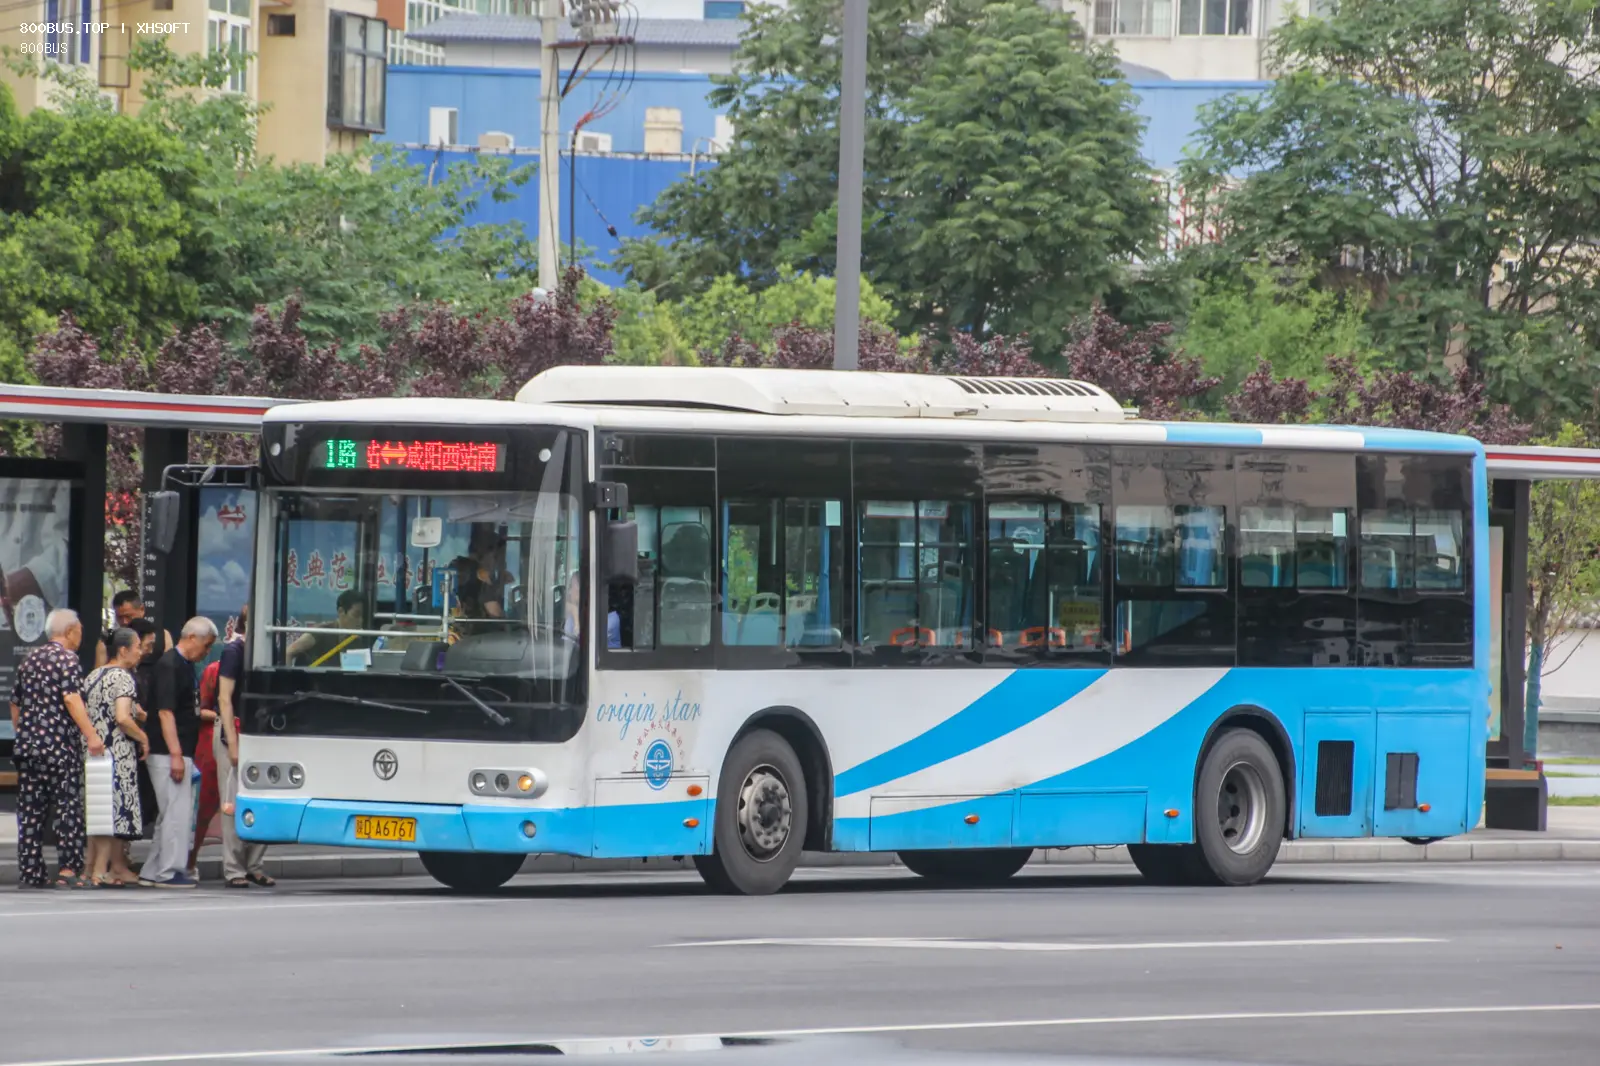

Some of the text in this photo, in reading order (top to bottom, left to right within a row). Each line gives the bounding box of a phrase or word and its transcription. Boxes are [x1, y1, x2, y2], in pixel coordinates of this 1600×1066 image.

[326, 439, 357, 469] 1路
[596, 689, 701, 741] origin star
